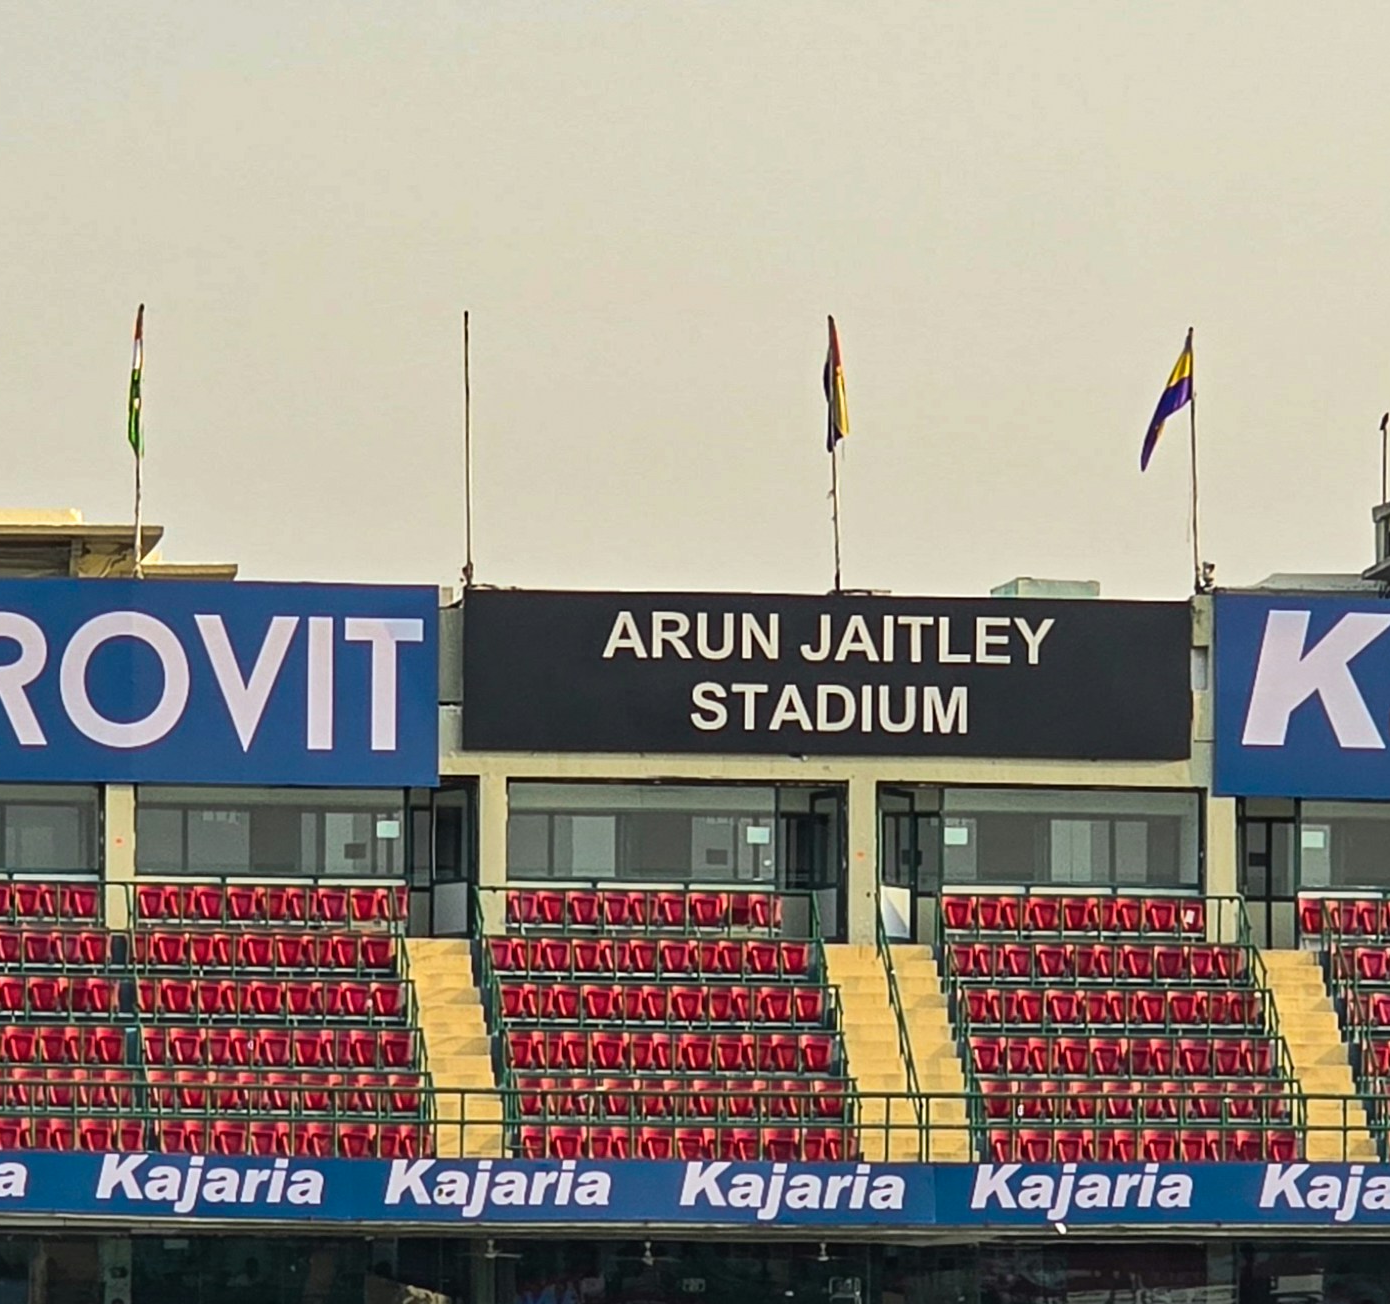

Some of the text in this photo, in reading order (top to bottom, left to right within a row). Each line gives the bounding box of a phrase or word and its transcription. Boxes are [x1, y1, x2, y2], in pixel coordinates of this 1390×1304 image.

[601, 611, 1055, 664] ARUN JAITLEY
[690, 682, 969, 734] STADIUM
[96, 1152, 325, 1214] Kajaria
[384, 1159, 611, 1218] Kajaria
[679, 1161, 906, 1220] Kajaria
[970, 1163, 1193, 1220] Kajaria
